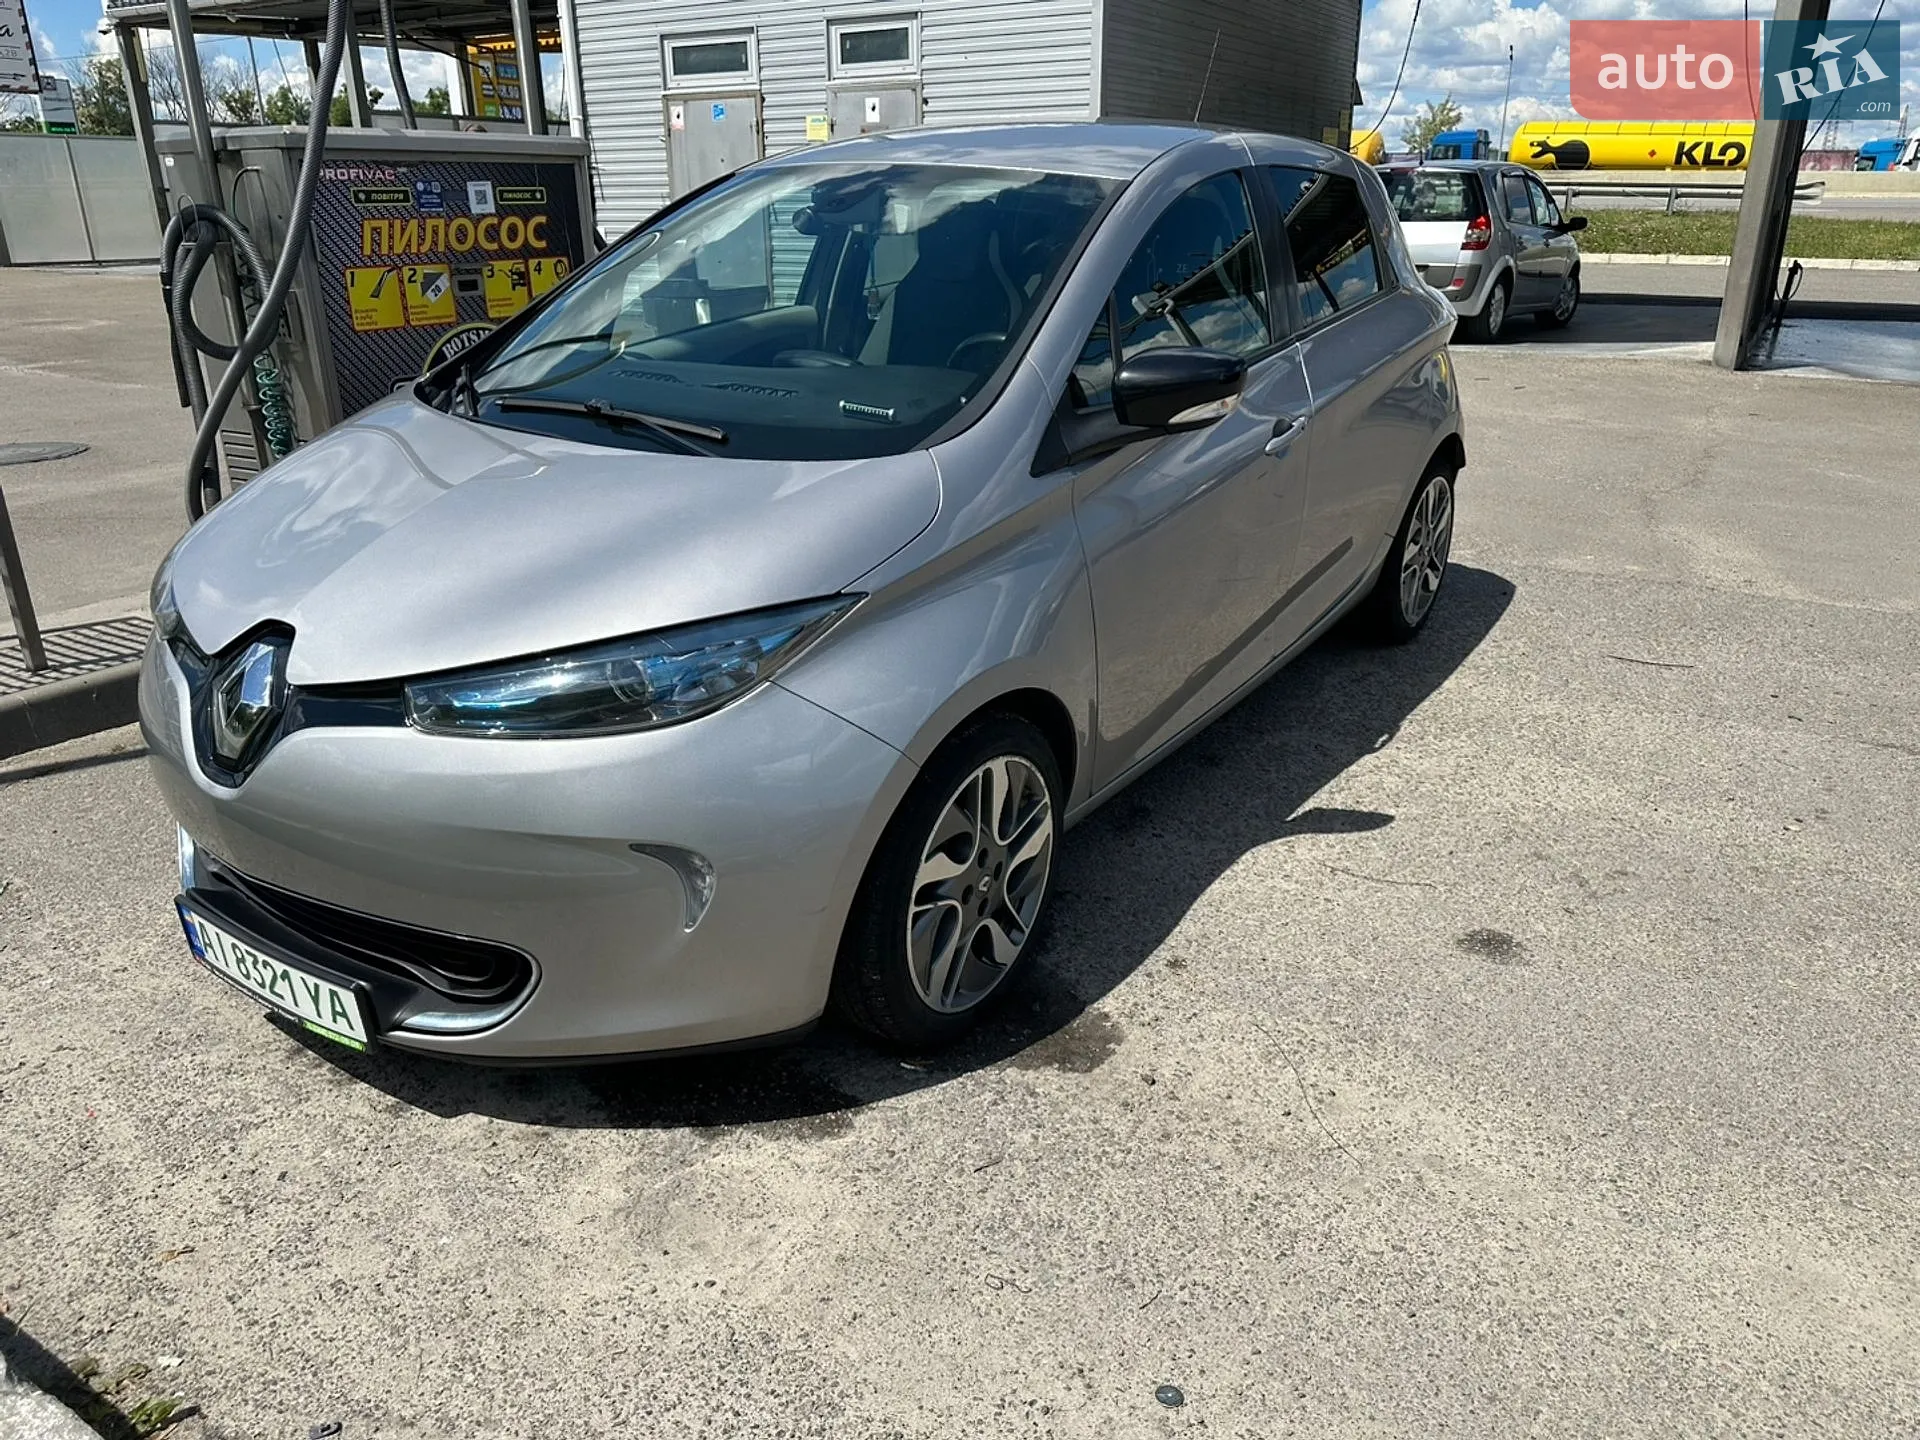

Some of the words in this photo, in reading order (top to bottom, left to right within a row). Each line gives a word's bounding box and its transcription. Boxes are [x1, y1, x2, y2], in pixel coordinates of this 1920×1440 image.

[1674, 141, 1747, 167] KLO
[362, 215, 548, 256] ПИЛОСОС
[407, 267, 418, 284] 2
[486, 263, 496, 279] 3
[533, 260, 543, 276] 4
[349, 270, 355, 288] 1
[231, 941, 300, 1008] 8321
[299, 975, 356, 1032] YA
